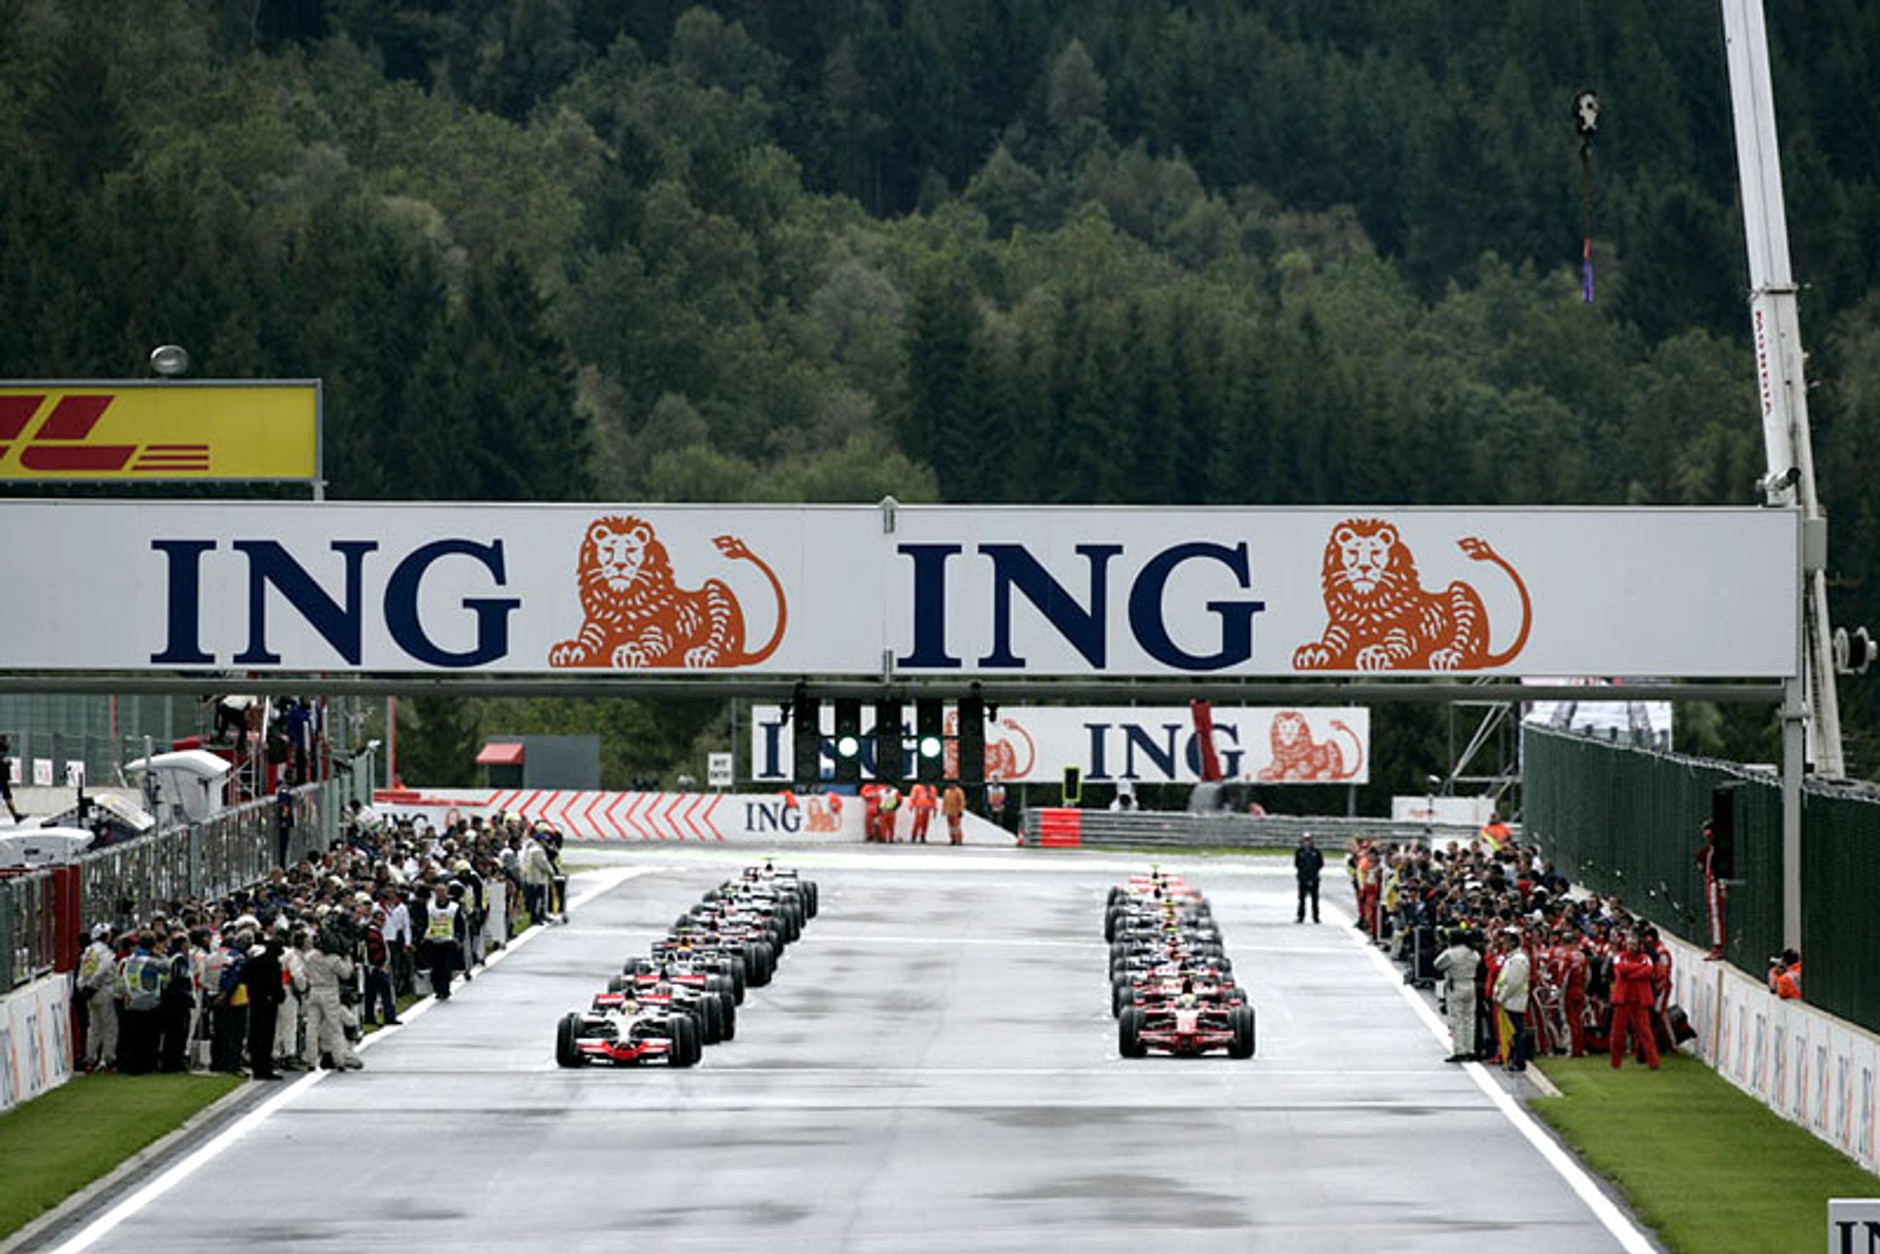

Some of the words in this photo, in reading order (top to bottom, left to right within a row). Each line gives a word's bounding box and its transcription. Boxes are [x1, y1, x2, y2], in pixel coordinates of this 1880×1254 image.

[150, 538, 521, 668] ING
[897, 541, 1265, 671] ING
[757, 721, 916, 778] IG
[1083, 722, 1245, 780] ING
[745, 802, 802, 833] ING
